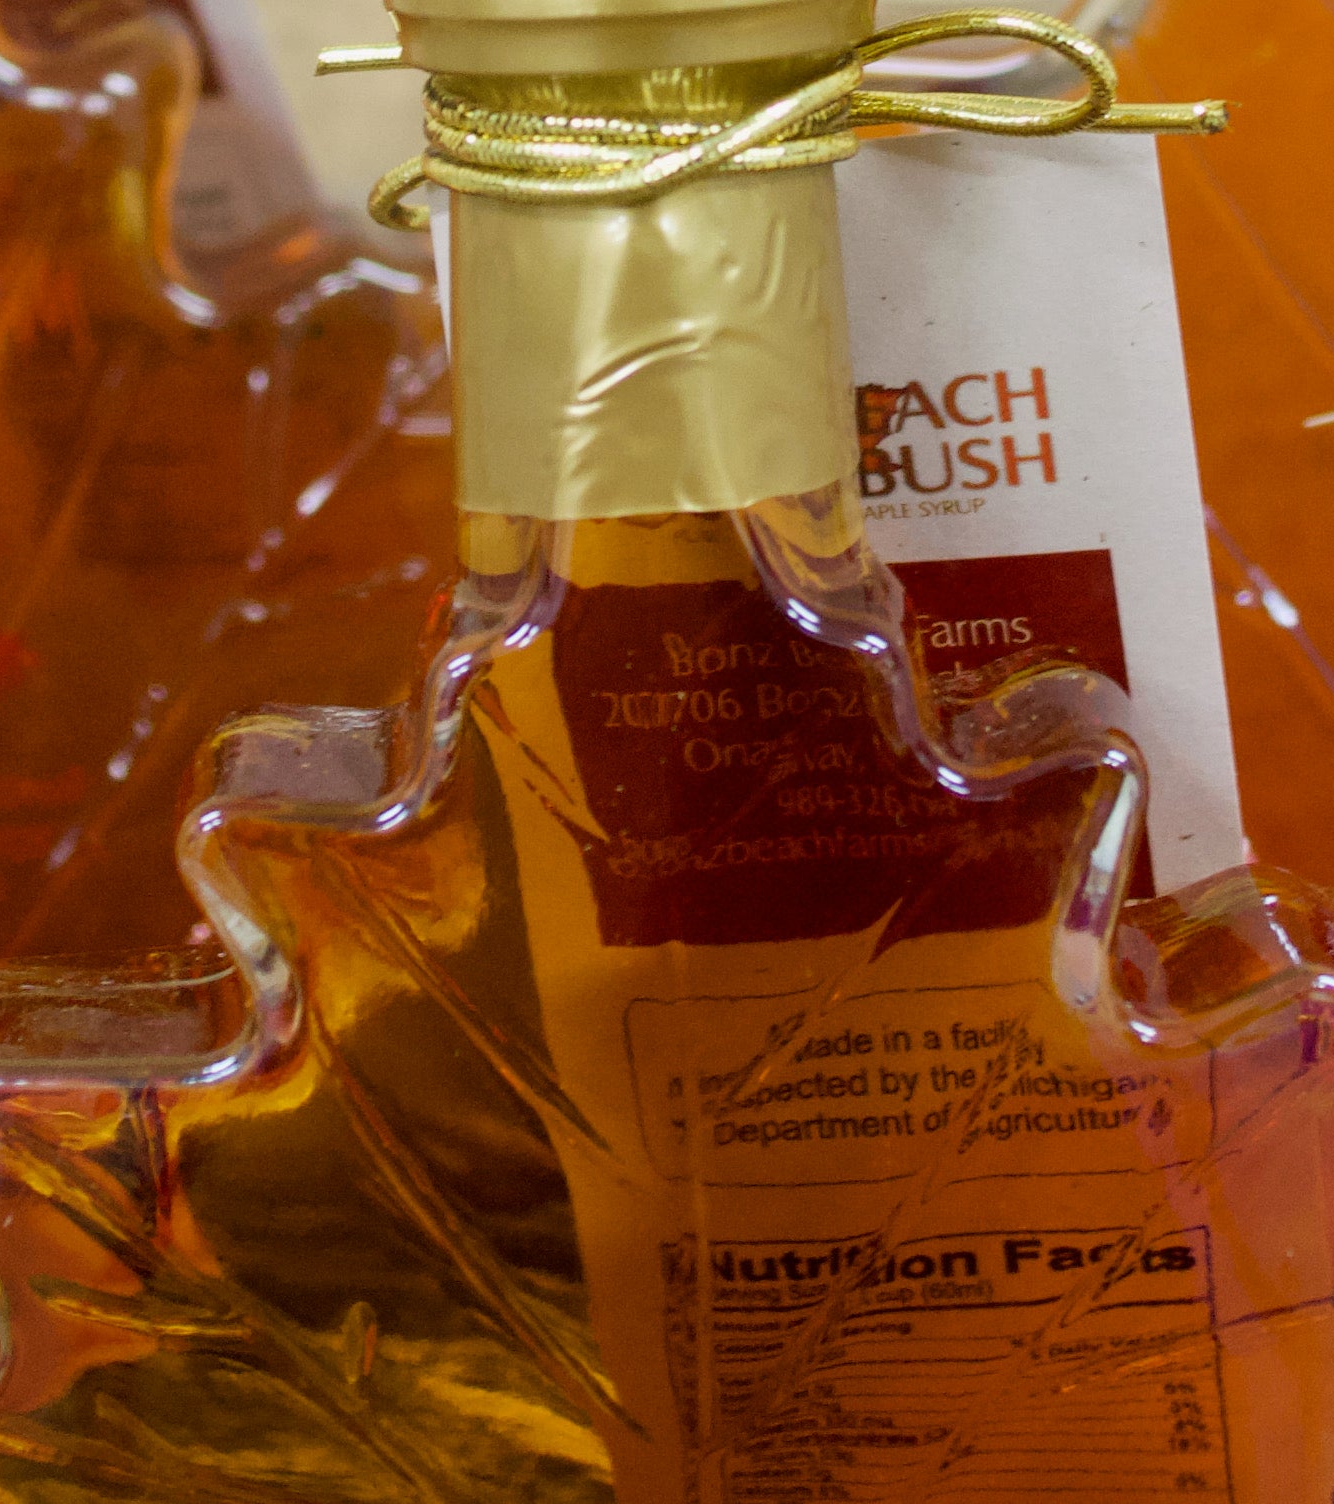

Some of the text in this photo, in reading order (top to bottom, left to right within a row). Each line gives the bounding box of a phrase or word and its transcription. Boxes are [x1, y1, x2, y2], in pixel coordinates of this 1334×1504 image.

[858, 431, 1058, 498] BUSH
[864, 496, 986, 521] APLE SYRUP
[882, 1027, 913, 1054] in
[922, 1029, 942, 1051] a
[879, 1066, 919, 1102] by
[930, 1065, 976, 1093] the
[713, 1110, 916, 1148] Department
[923, 1102, 953, 1134] of
